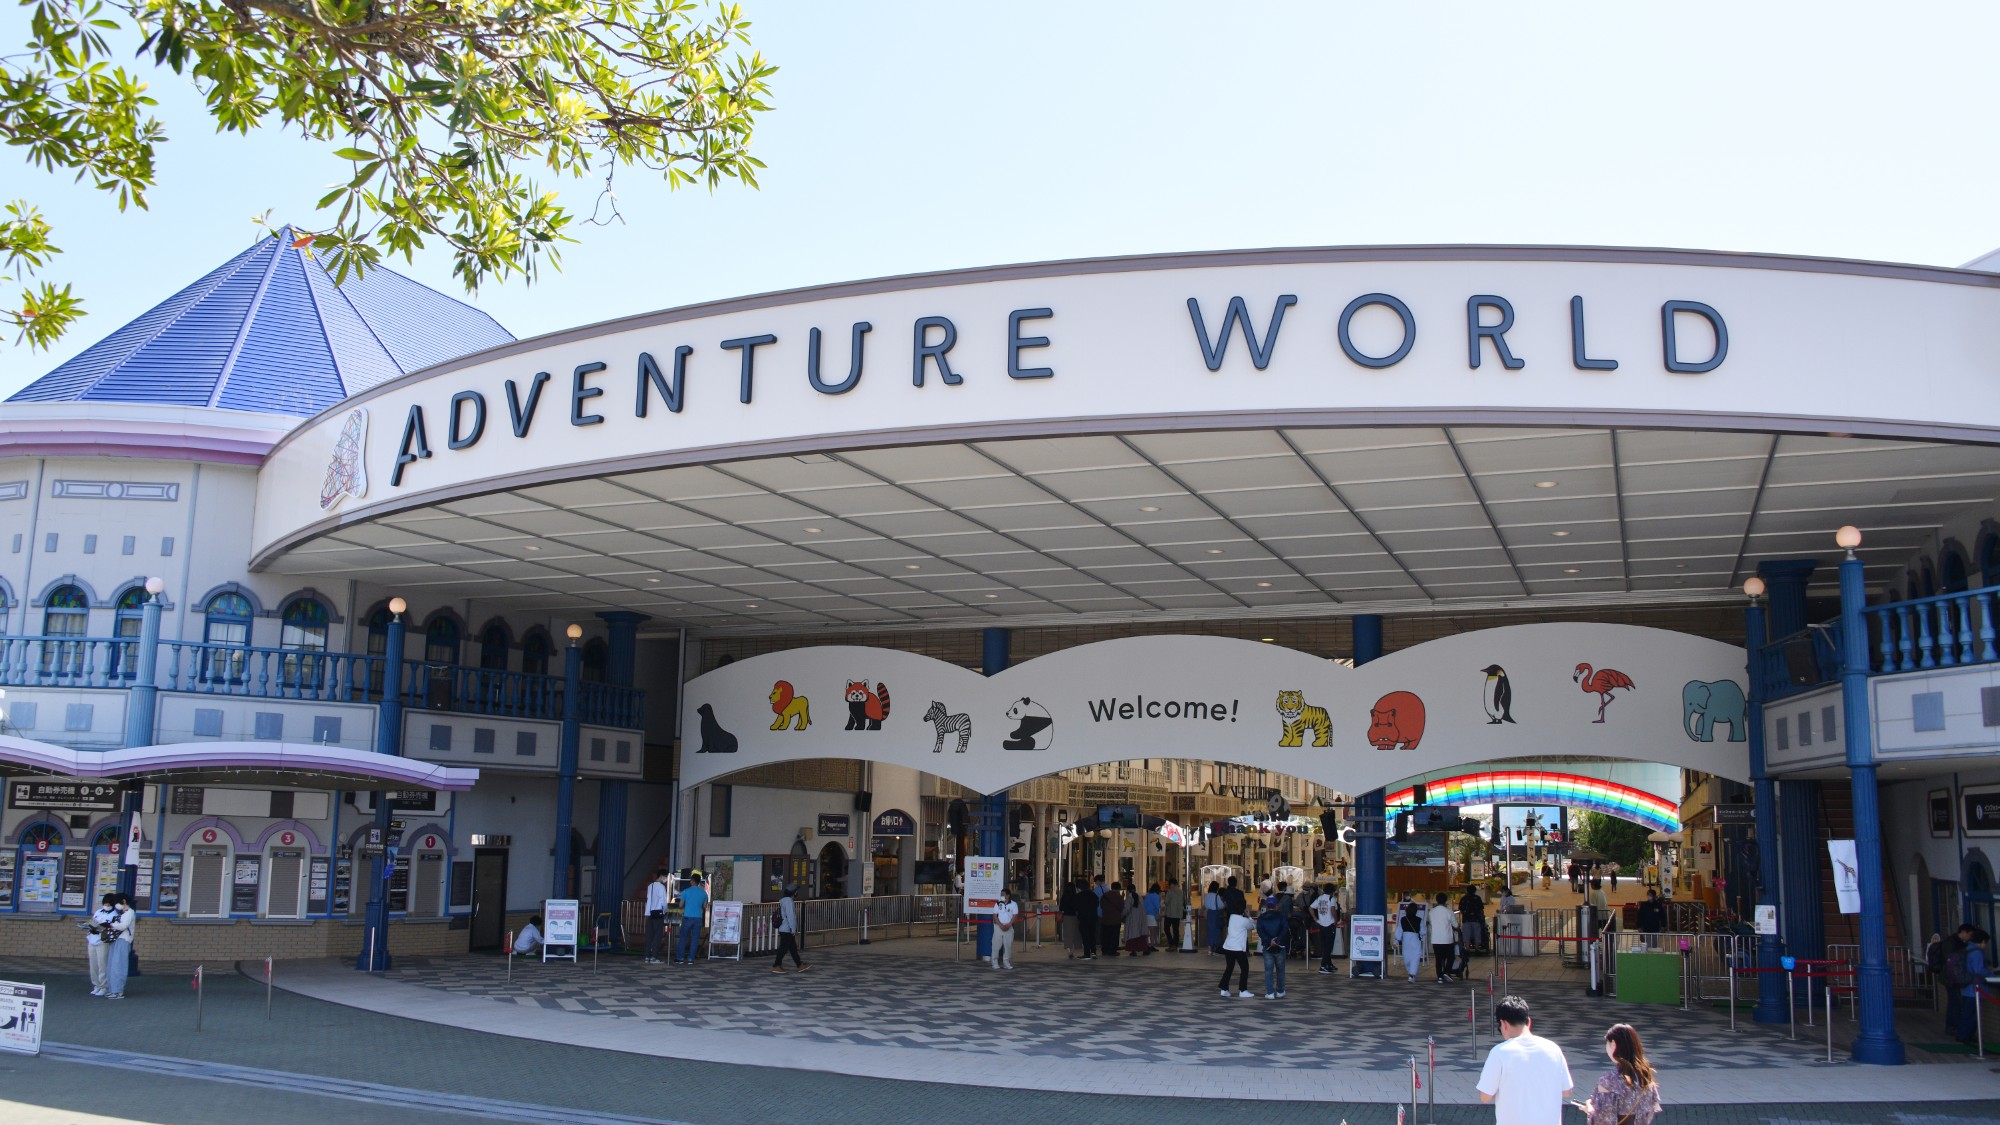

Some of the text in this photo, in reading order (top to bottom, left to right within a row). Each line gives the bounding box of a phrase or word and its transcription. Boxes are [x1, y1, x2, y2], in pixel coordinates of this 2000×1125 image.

[390, 293, 1729, 487] ADVENTURE WORLD
[1088, 695, 1239, 723] Welcome!
[38, 786, 75, 795] 自動券売機
[1274, 824, 1309, 836] you
[206, 832, 213, 841] 4
[284, 834, 292, 843] 3
[38, 841, 46, 850] 6
[111, 843, 119, 852] 5
